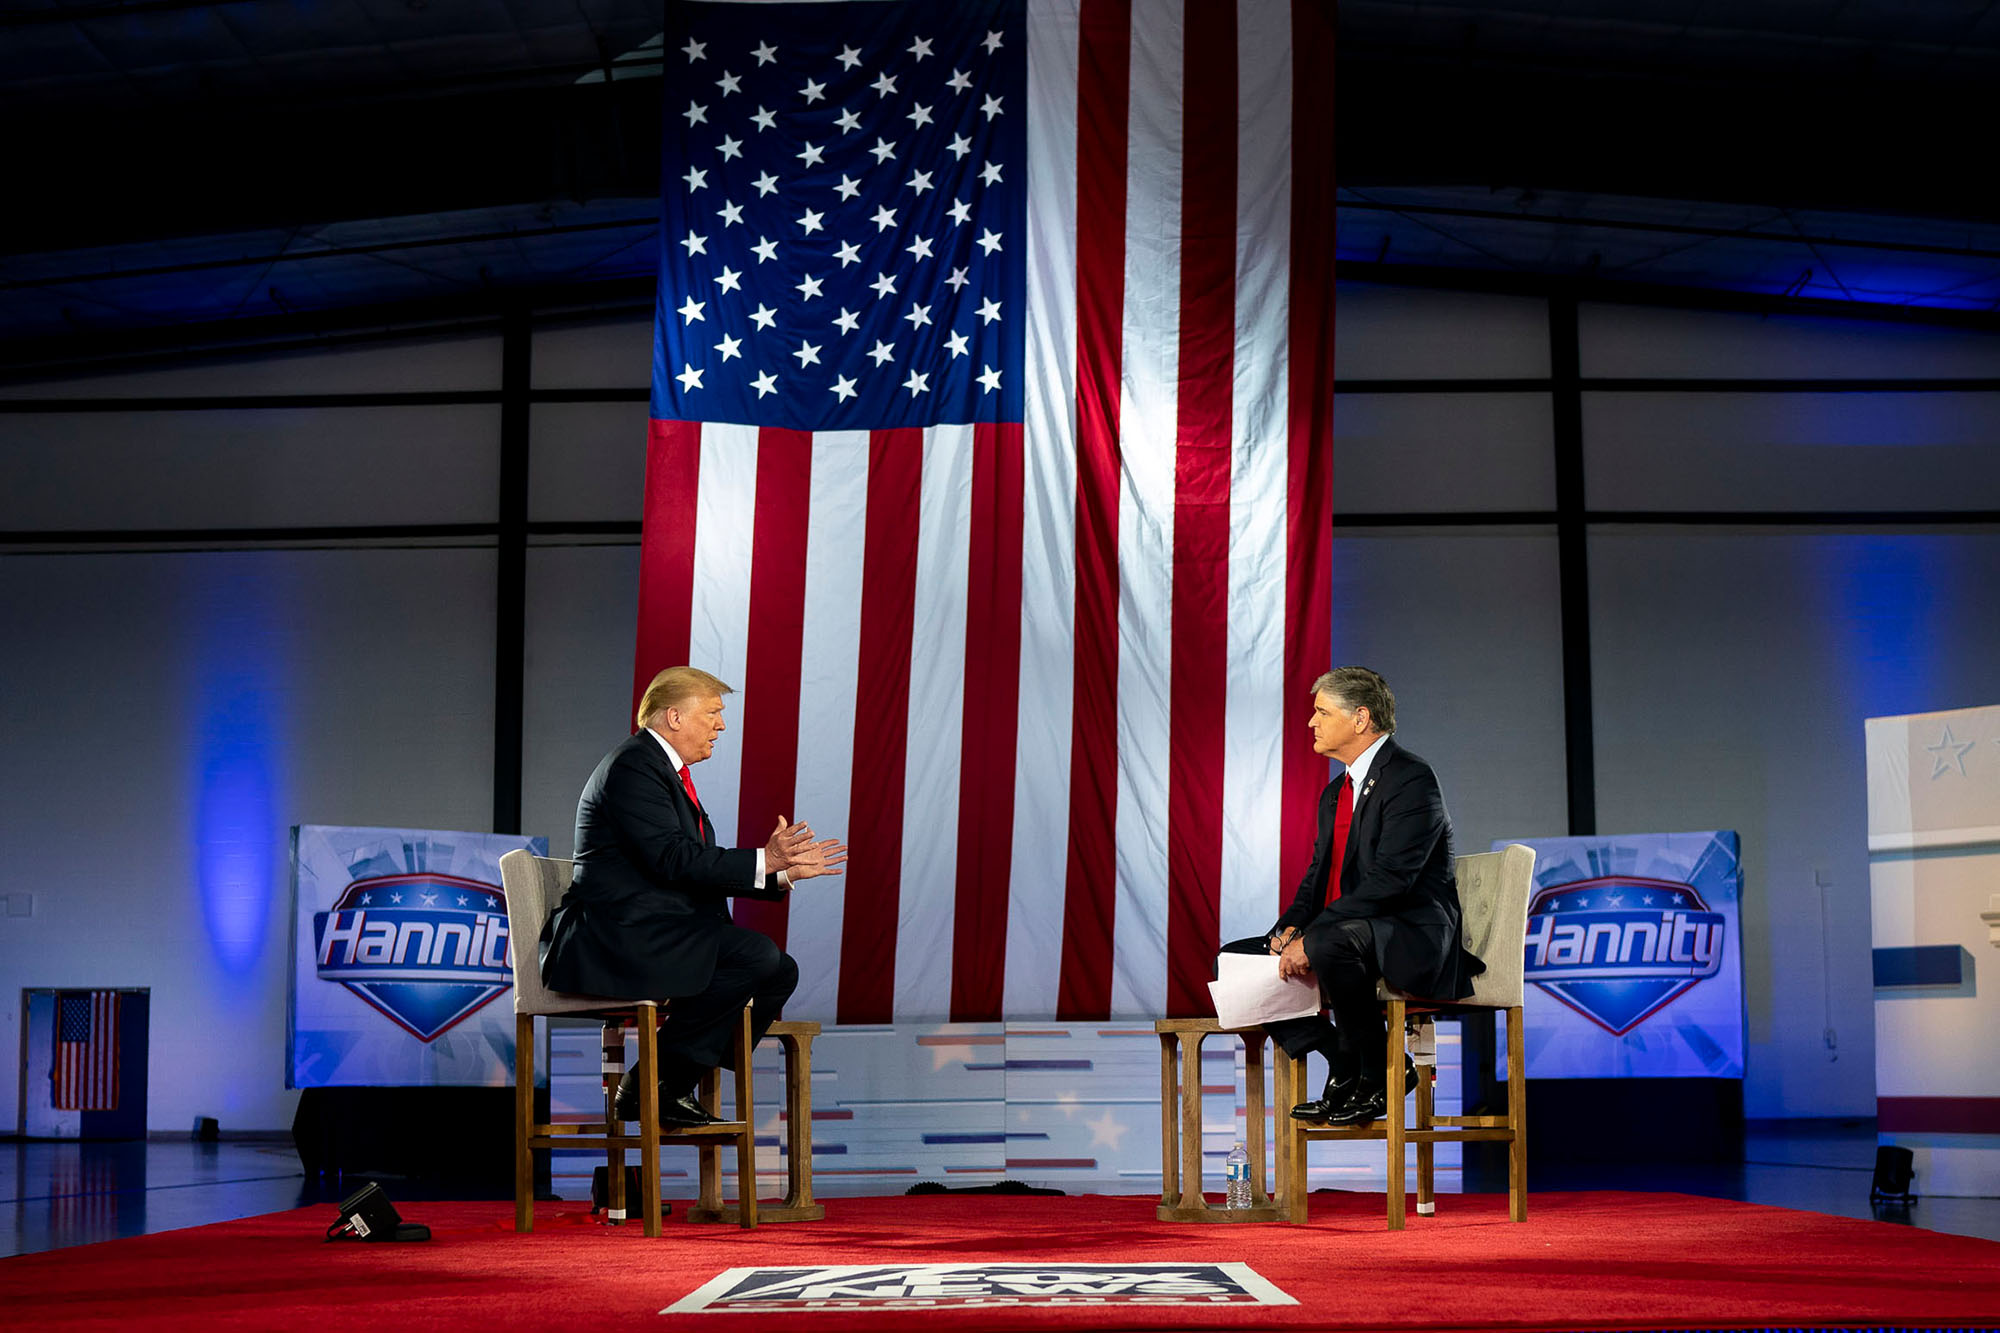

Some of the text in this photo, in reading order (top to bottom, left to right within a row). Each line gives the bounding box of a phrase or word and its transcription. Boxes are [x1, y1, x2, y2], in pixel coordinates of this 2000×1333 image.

[317, 910, 514, 969] Hannit
[1524, 910, 1723, 977] Hannity
[797, 1282, 1229, 1299] NEWS
[903, 1272, 1213, 1286] FOX
